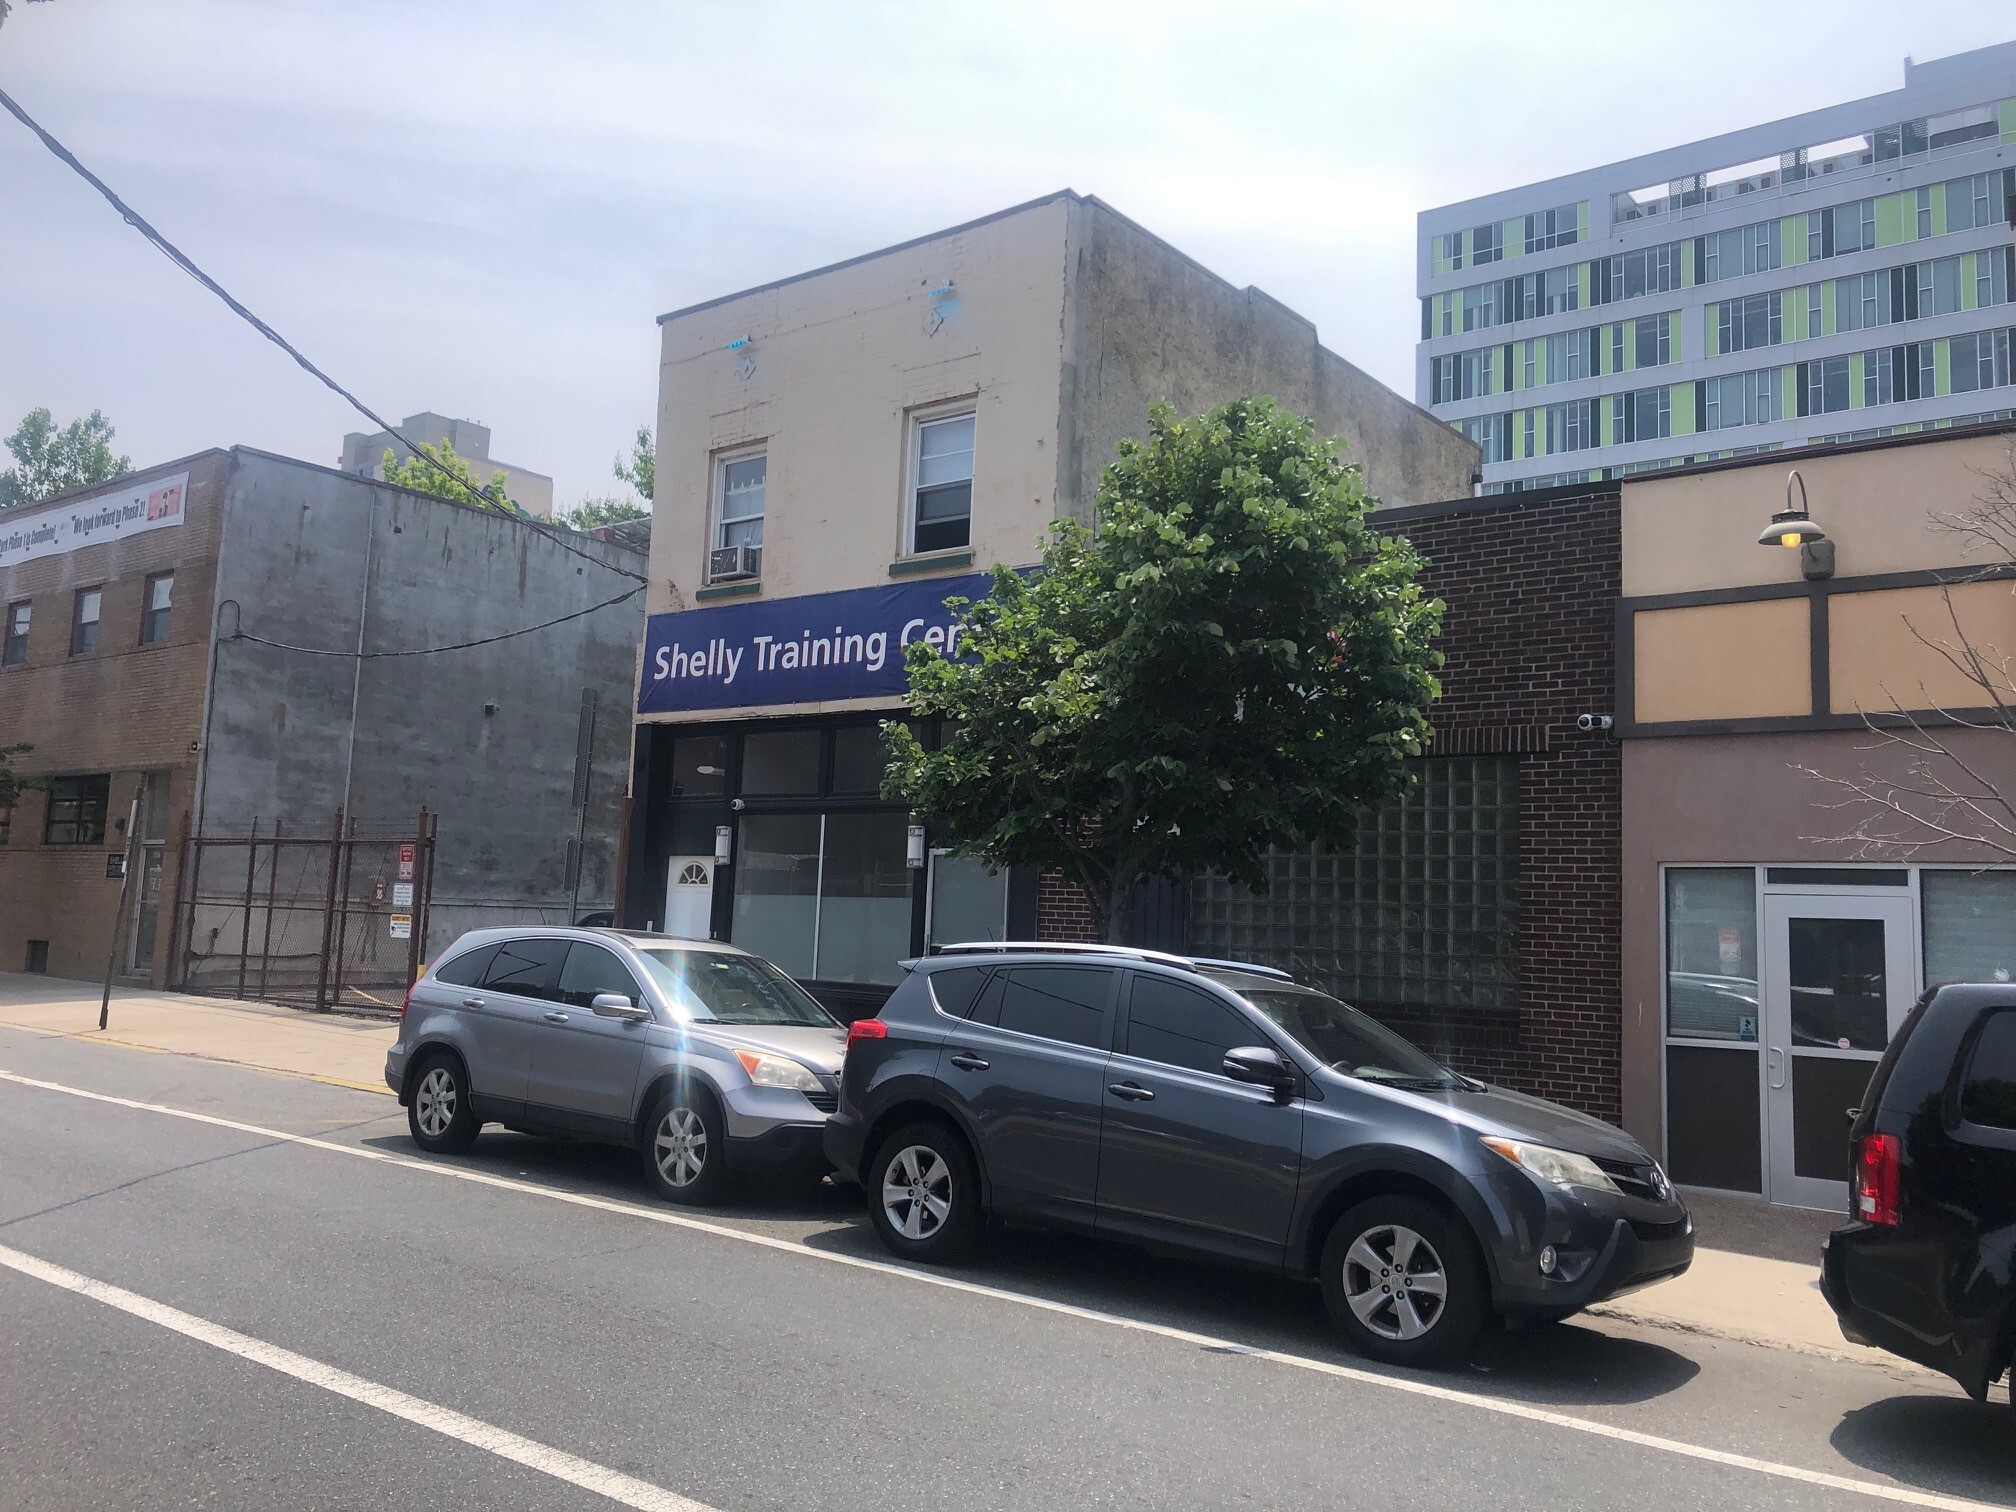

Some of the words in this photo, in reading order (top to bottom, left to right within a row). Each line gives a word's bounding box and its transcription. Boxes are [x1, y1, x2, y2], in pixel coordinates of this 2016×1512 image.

[82, 514, 94, 532] look
[94, 509, 116, 528] forward
[122, 504, 139, 523] Phase
[653, 638, 744, 684] Shelly
[753, 626, 888, 672] Training
